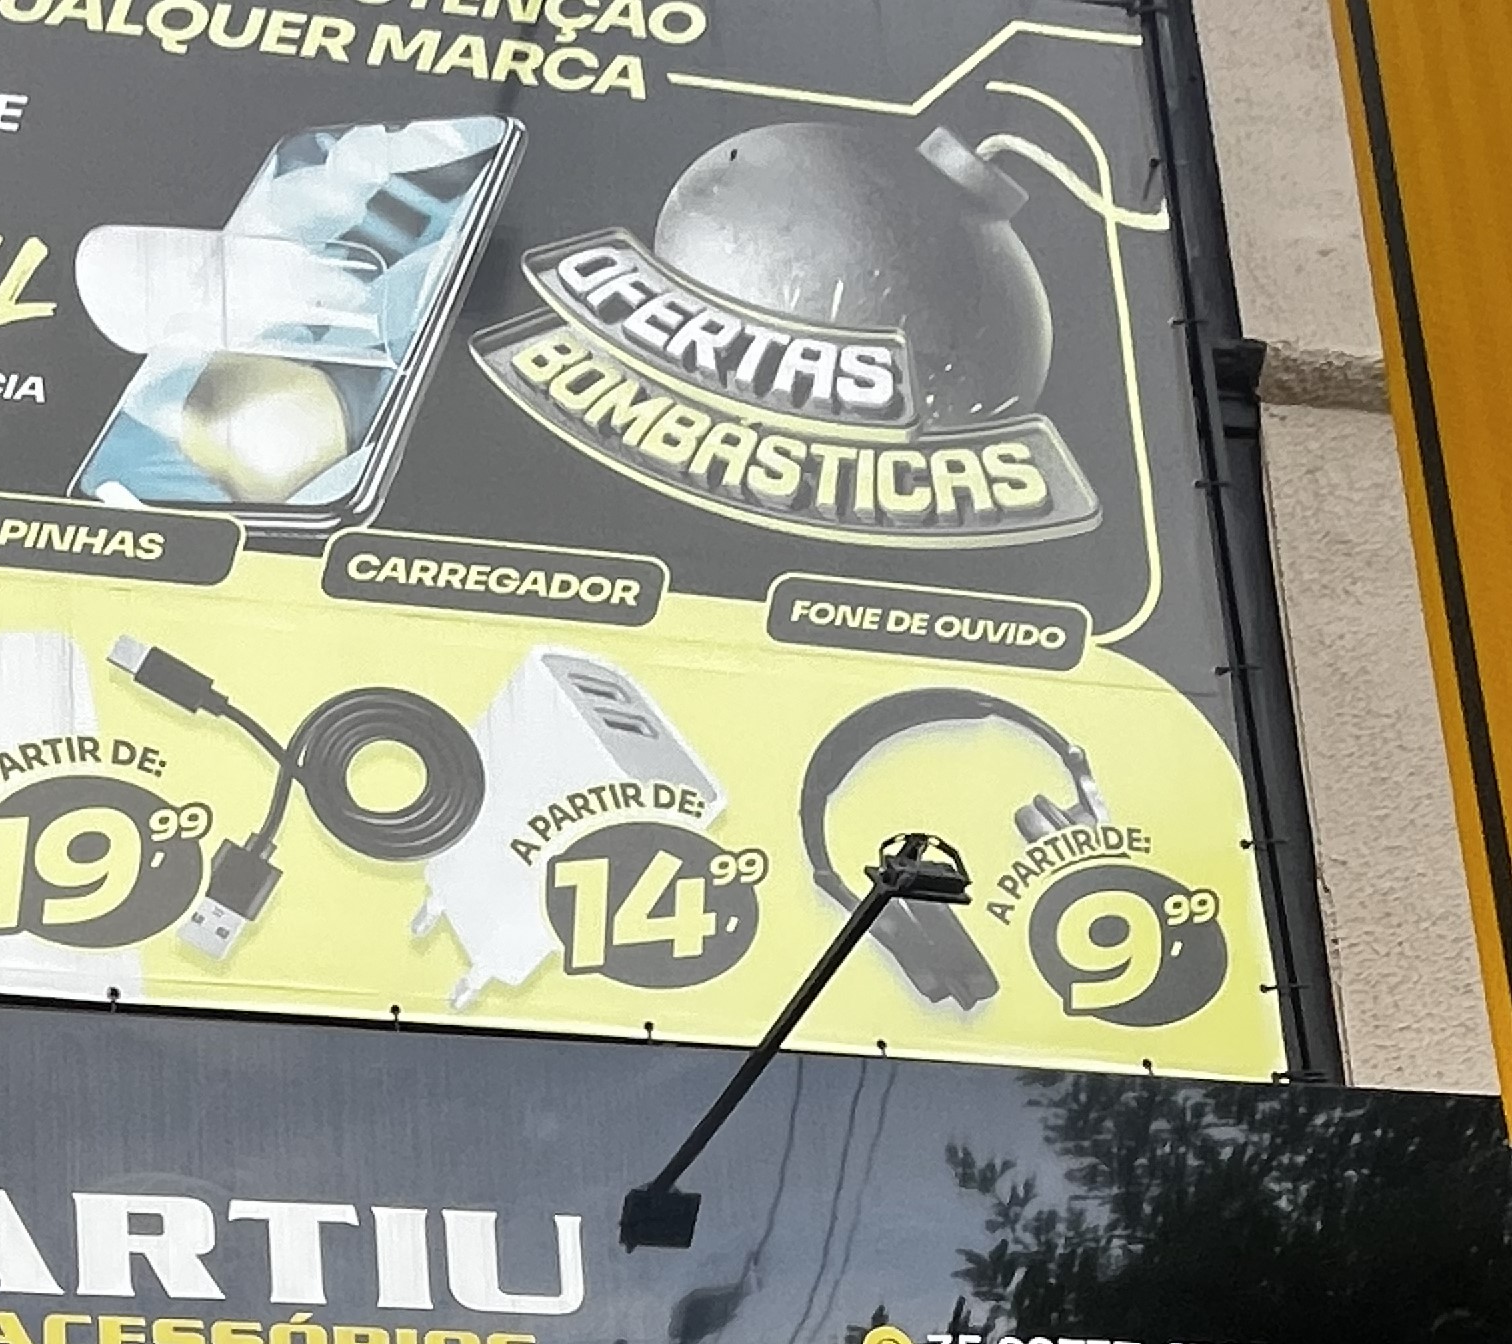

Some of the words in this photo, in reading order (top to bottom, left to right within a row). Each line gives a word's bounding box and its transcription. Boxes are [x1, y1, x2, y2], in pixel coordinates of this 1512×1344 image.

[366, 23, 647, 100] MARCA
[554, 246, 897, 408] OFERTAS
[509, 335, 1052, 524] BOMBÁSTICAS
[346, 553, 642, 607] CARREGADOR
[789, 598, 882, 634] FONE
[885, 610, 928, 637] DE
[933, 615, 1068, 650] OUVIDO
[110, 738, 168, 779] DE:
[508, 836, 541, 867] A
[533, 781, 646, 843] PARTIR
[652, 782, 707, 820] DE:
[1102, 825, 1153, 855] DE:
[997, 826, 1100, 902] PARTIR
[986, 899, 1016, 927] A
